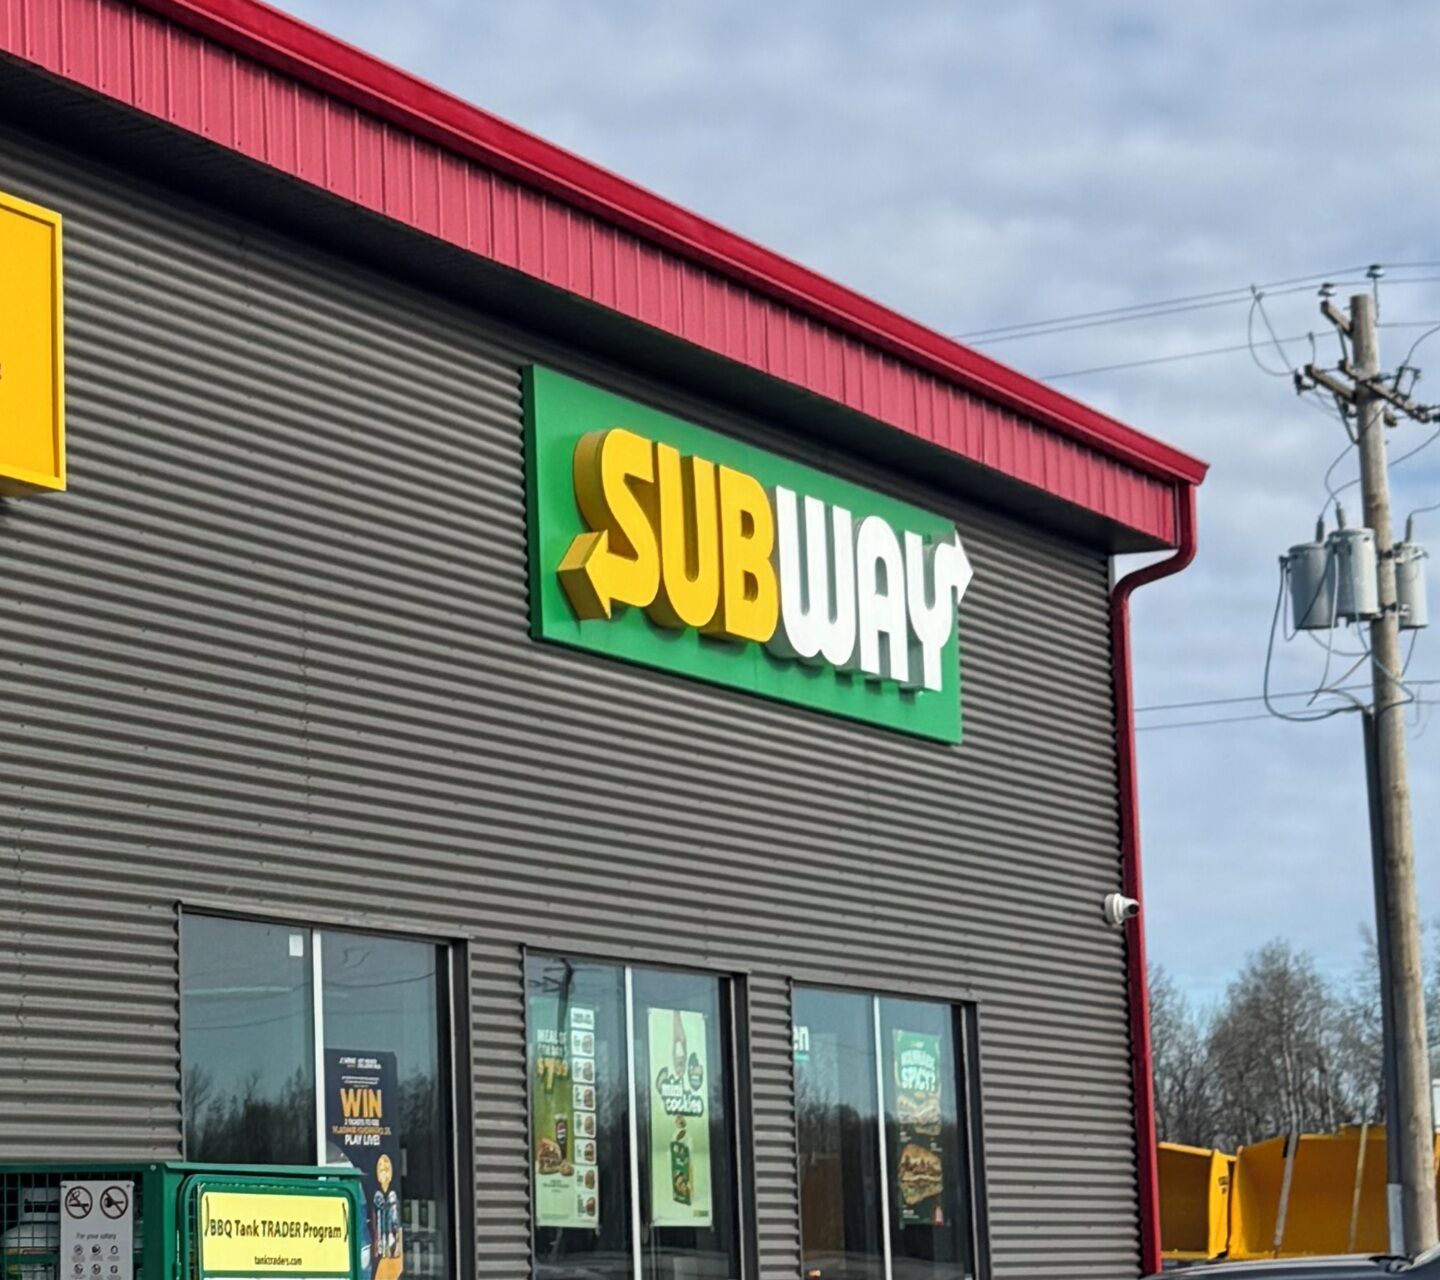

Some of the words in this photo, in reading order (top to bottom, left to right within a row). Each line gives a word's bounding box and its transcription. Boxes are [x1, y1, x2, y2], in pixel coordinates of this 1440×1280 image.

[557, 428, 974, 692] SUBWAY
[340, 1088, 382, 1118] WIN
[665, 1093, 702, 1113] cookies
[210, 1219, 232, 1238] BBQ
[234, 1220, 259, 1237] Tank
[262, 1221, 301, 1238] TRADER
[303, 1222, 342, 1243] Program
[254, 1254, 302, 1266] tanktraders.com
